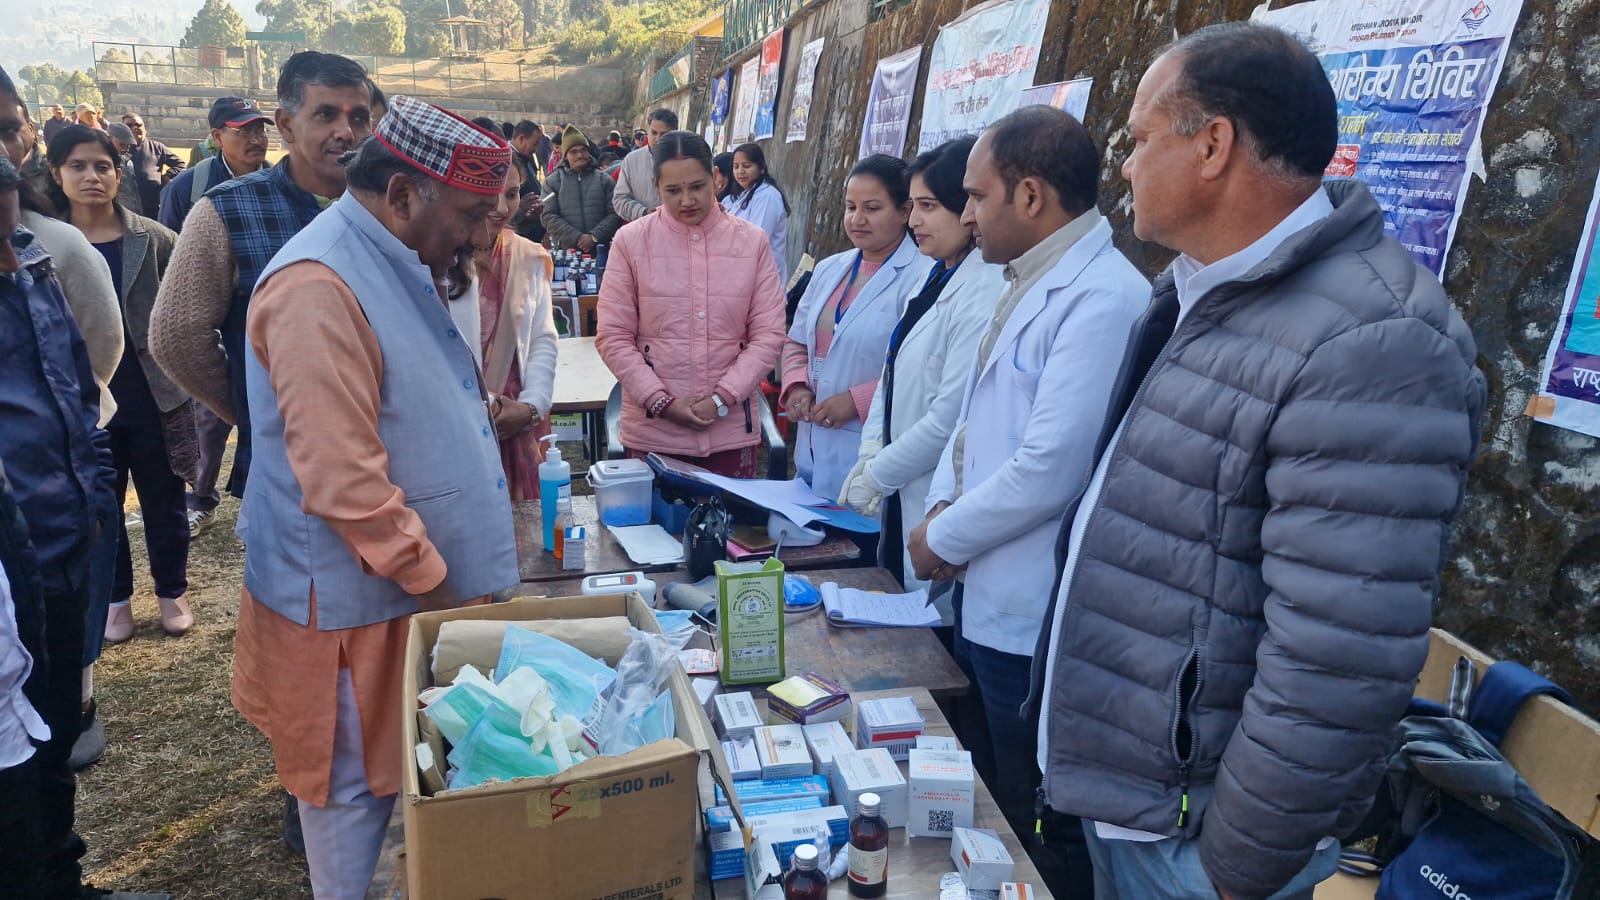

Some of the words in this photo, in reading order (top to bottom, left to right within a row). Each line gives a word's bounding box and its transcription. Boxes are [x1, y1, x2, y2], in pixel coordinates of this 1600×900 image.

[1330, 53, 1401, 101] आरोग्य
[1401, 45, 1486, 100] शिविर
[576, 778, 644, 802] 25x500
[649, 771, 675, 789] ml.
[592, 882, 663, 900] RENTERALS
